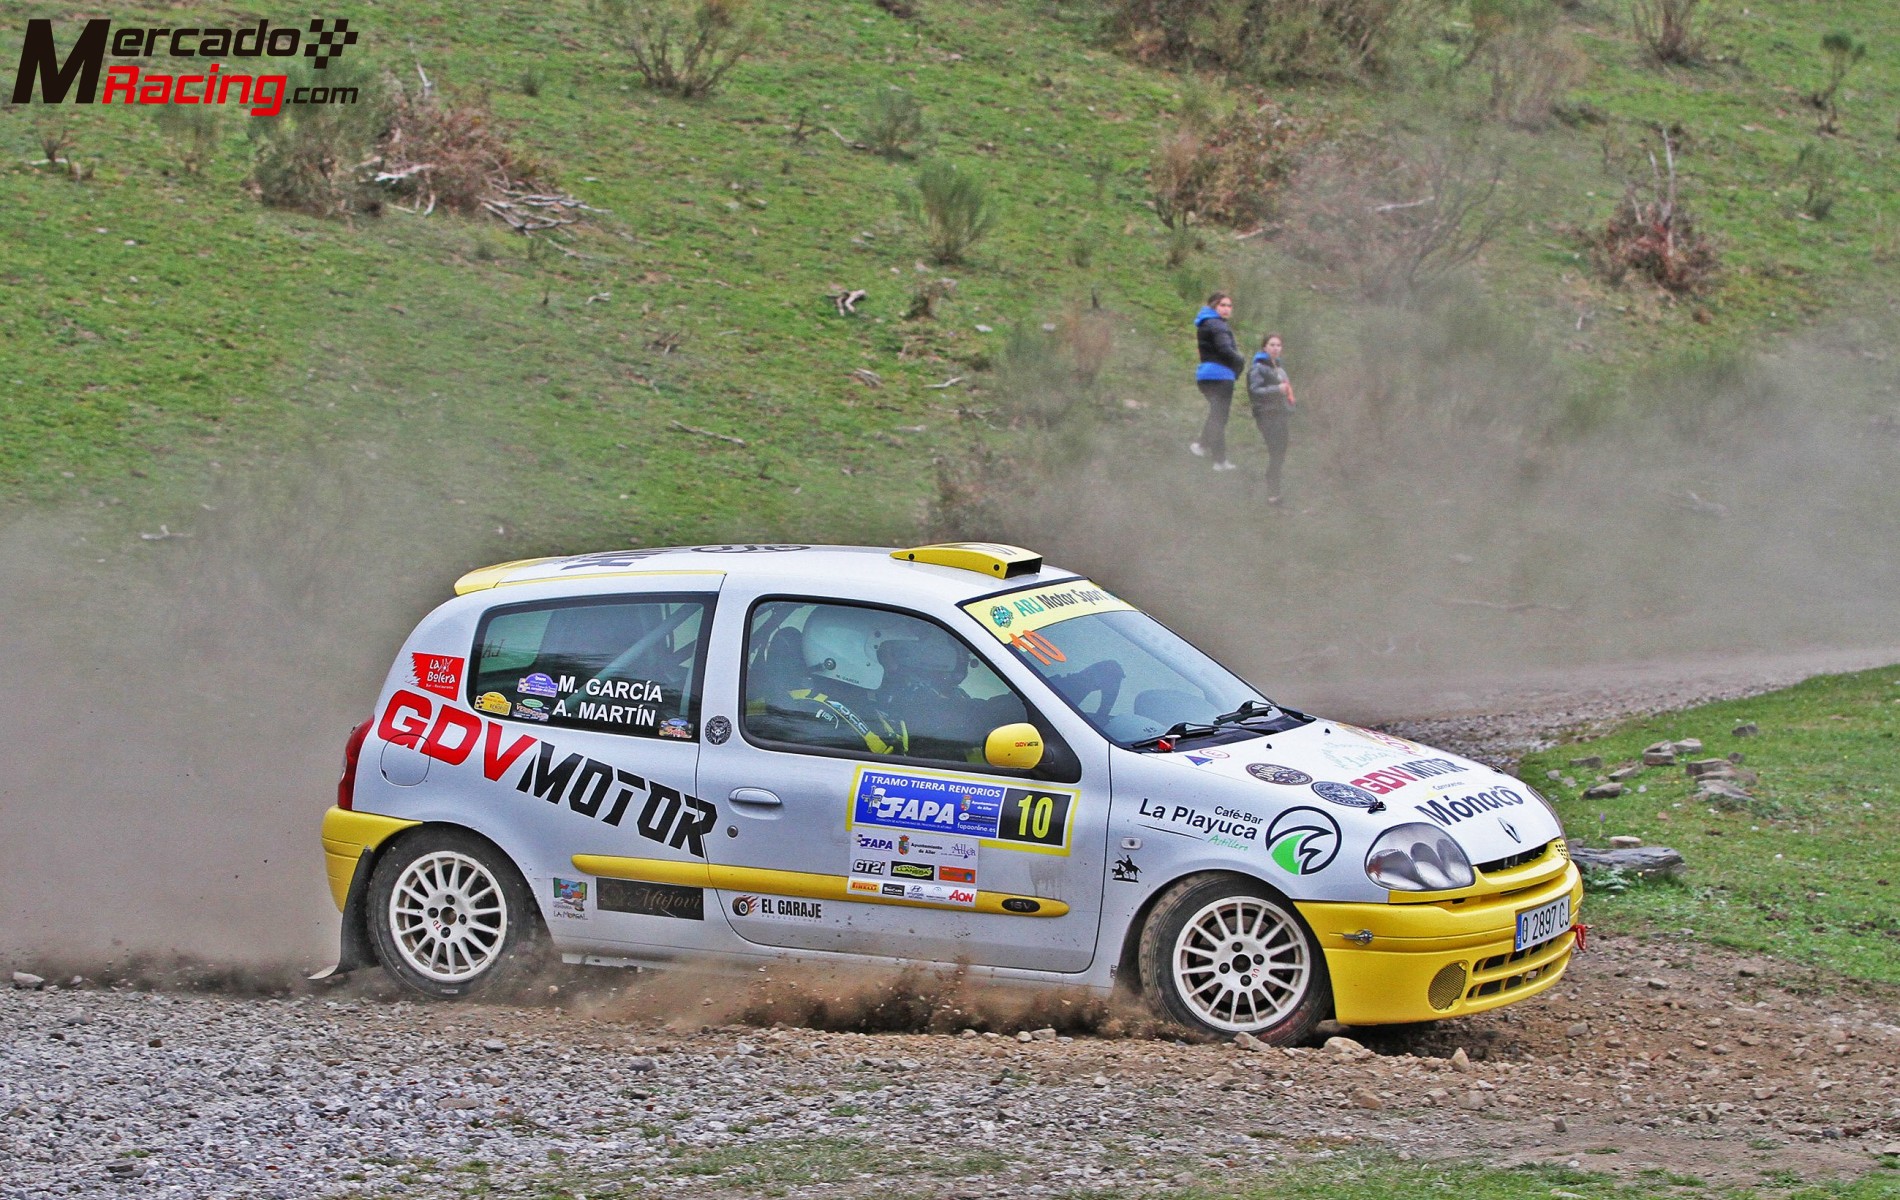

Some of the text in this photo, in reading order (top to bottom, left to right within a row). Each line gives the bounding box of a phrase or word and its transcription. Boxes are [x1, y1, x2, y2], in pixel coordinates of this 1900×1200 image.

[1015, 596, 1044, 617] ARJ
[1037, 589, 1078, 610] Motor
[1009, 629, 1067, 666] 10
[427, 671, 456, 684] Bolera
[557, 675, 579, 694] M.
[585, 678, 663, 703] GARCÍA
[552, 699, 572, 718] A.
[578, 702, 656, 727] MARTÍN
[871, 775, 909, 787] TRAMO
[911, 780, 946, 792] TIERRA
[948, 785, 1001, 798] RENORIOS
[877, 797, 955, 825] FAPA
[1017, 795, 1054, 839] 10
[1139, 798, 1258, 840] La Playuca
[1214, 806, 1263, 825] Café-Bar
[957, 822, 996, 833] fapaonline.es
[860, 837, 893, 850] FAPA
[853, 860, 885, 875] GT2i
[761, 898, 822, 919] EL GARAJE
[949, 890, 974, 903] AON
[1532, 904, 1557, 941] 2897
[1559, 898, 1570, 928] CJ
